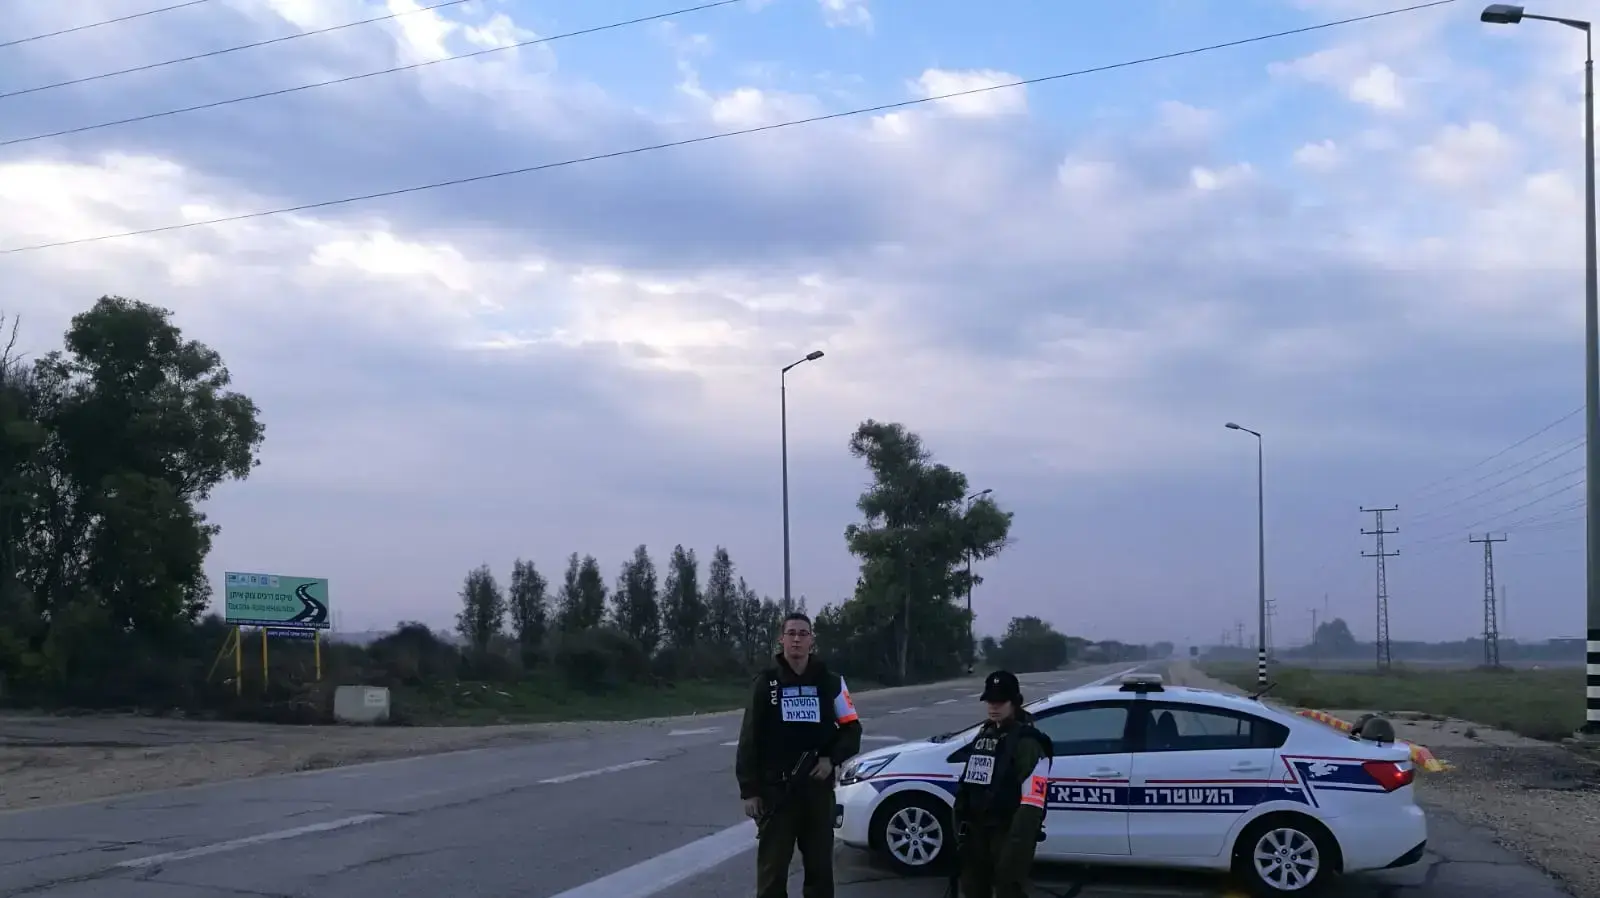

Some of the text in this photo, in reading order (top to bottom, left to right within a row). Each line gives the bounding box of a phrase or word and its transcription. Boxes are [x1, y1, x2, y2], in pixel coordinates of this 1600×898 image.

[783, 698, 818, 708] המשטרה
[786, 710, 817, 720] הצבאית
[1051, 786, 1234, 804] המשטרה הצבאי
